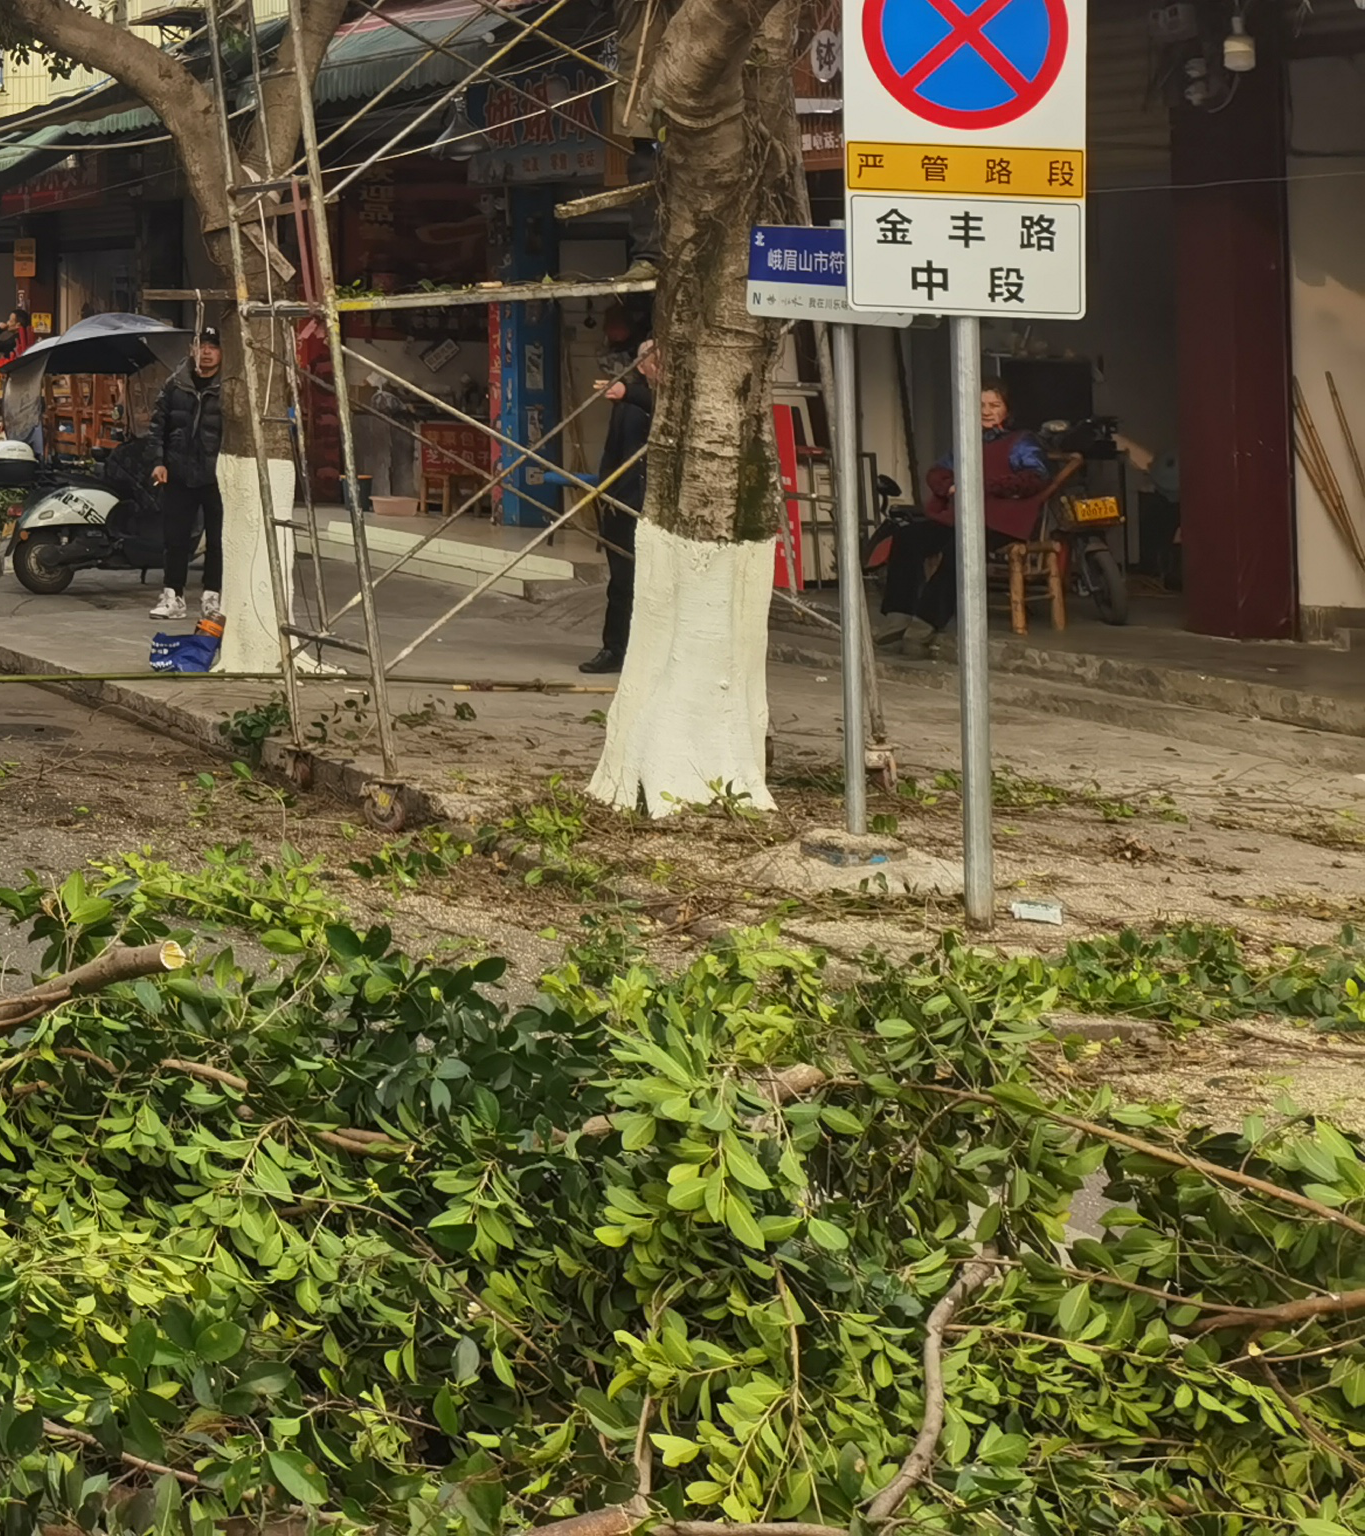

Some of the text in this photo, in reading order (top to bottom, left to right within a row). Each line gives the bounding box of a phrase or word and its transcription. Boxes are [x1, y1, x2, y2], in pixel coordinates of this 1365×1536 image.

[857, 153, 1074, 187] 严管路段
[876, 208, 1057, 252] 金丰路
[767, 248, 845, 274] 峨眉山市符
[752, 292, 762, 305] N
[911, 260, 1025, 304] 中段
